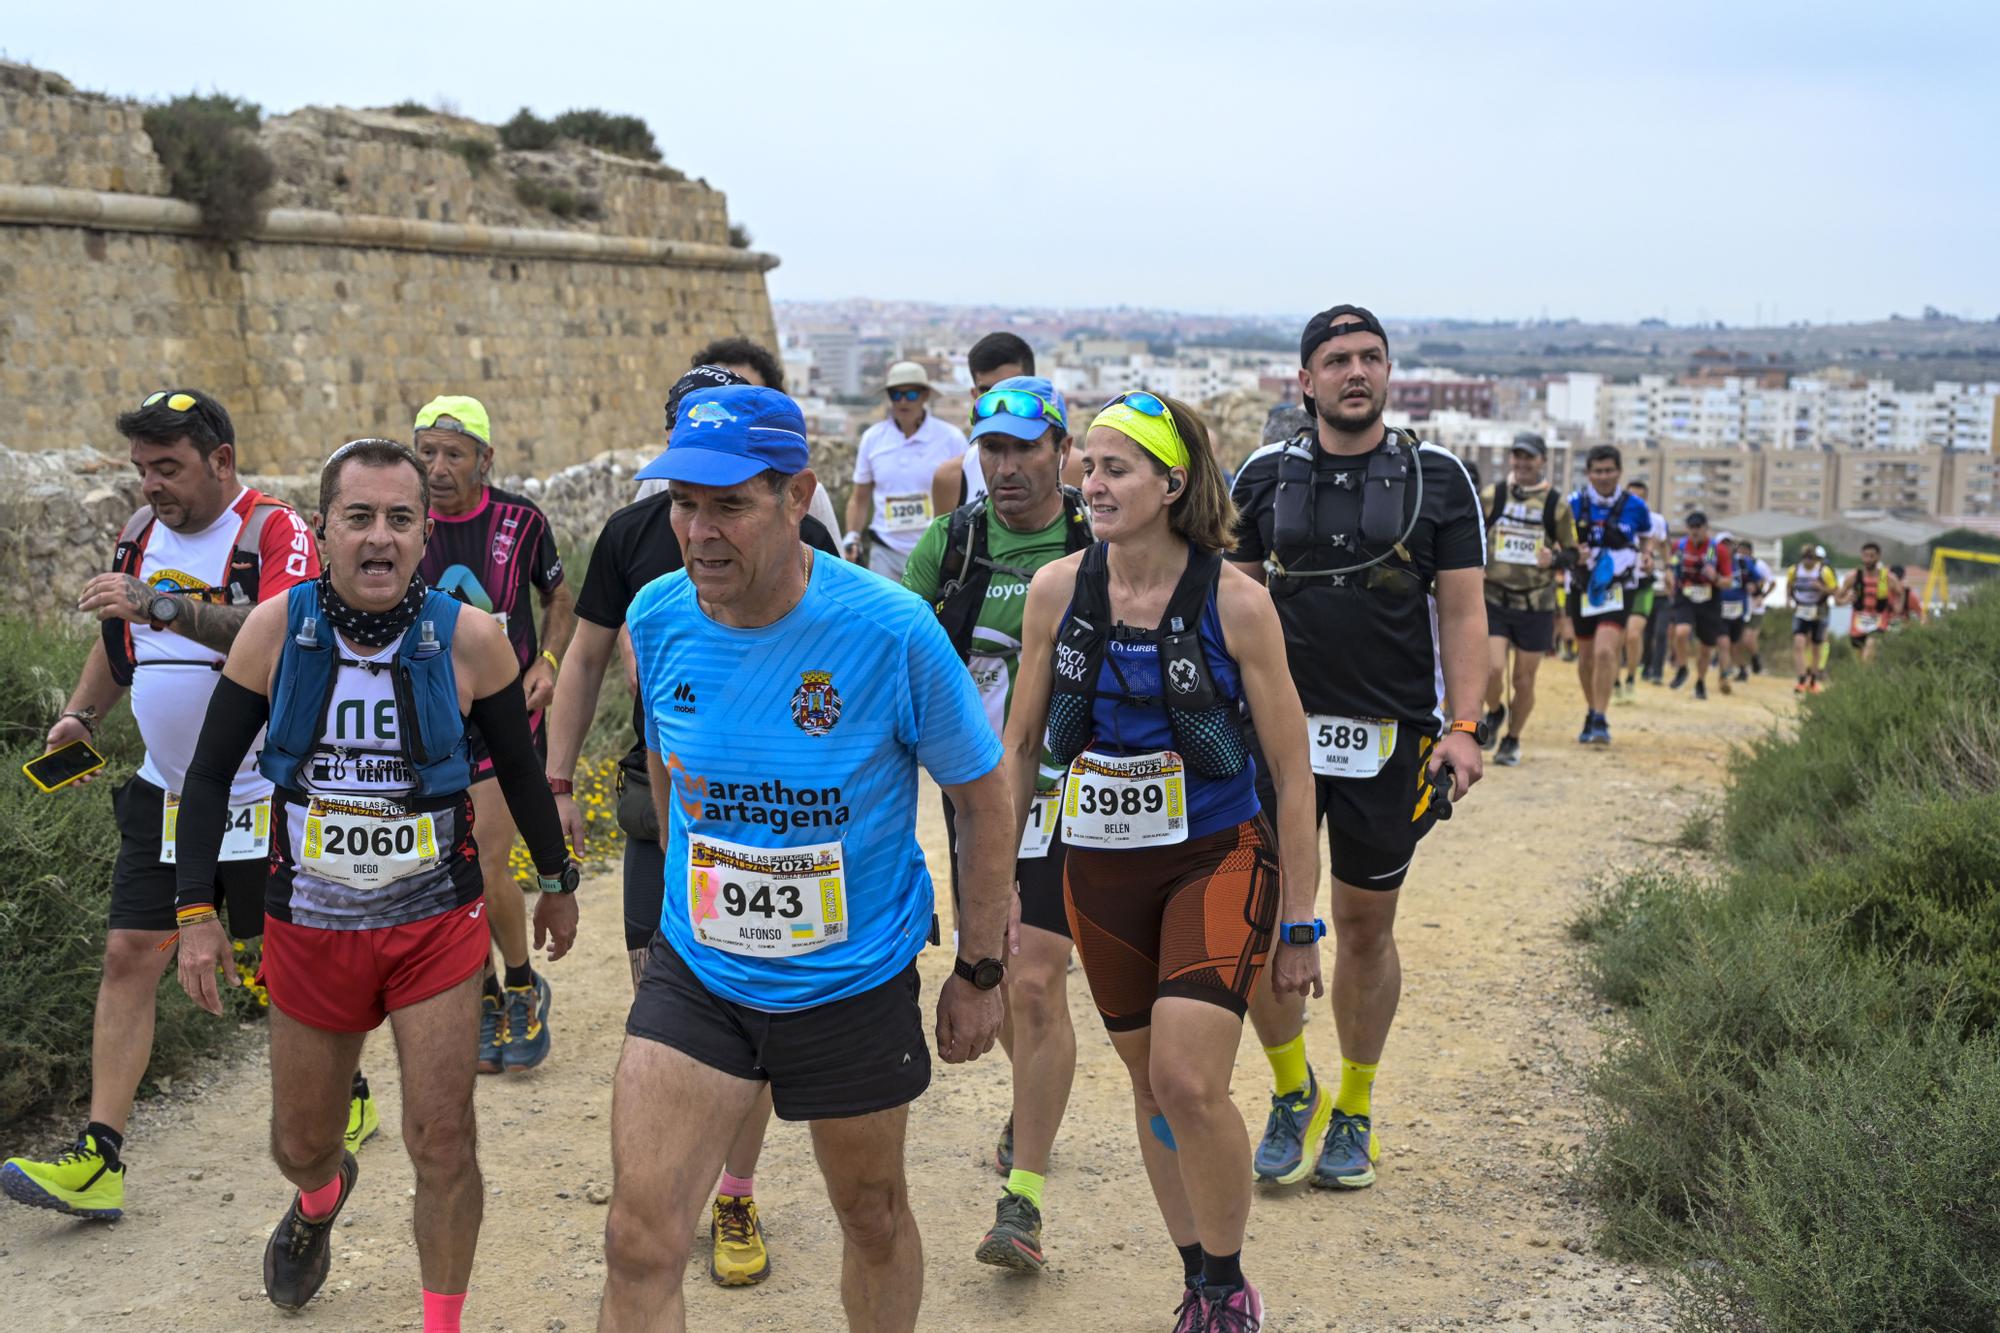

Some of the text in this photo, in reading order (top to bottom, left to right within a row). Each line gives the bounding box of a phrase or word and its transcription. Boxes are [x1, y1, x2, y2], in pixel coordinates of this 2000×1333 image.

[1504, 539, 1535, 551] 4100
[1056, 658, 1087, 682] MAX
[673, 704, 696, 714] mobel
[1316, 724, 1369, 751] 589
[1112, 762, 1128, 770] LAS
[1326, 754, 1349, 765] MAXIM
[1129, 764, 1161, 776] 2023
[364, 801, 380, 810] LAS
[1080, 784, 1164, 816] 3989
[324, 825, 415, 856] 2060
[738, 851, 749, 862] DE
[751, 853, 769, 864] LAS
[353, 864, 378, 874] DIEGO
[771, 859, 813, 873] 2023
[722, 882, 804, 919] 943
[739, 926, 782, 940] ALFONSO
